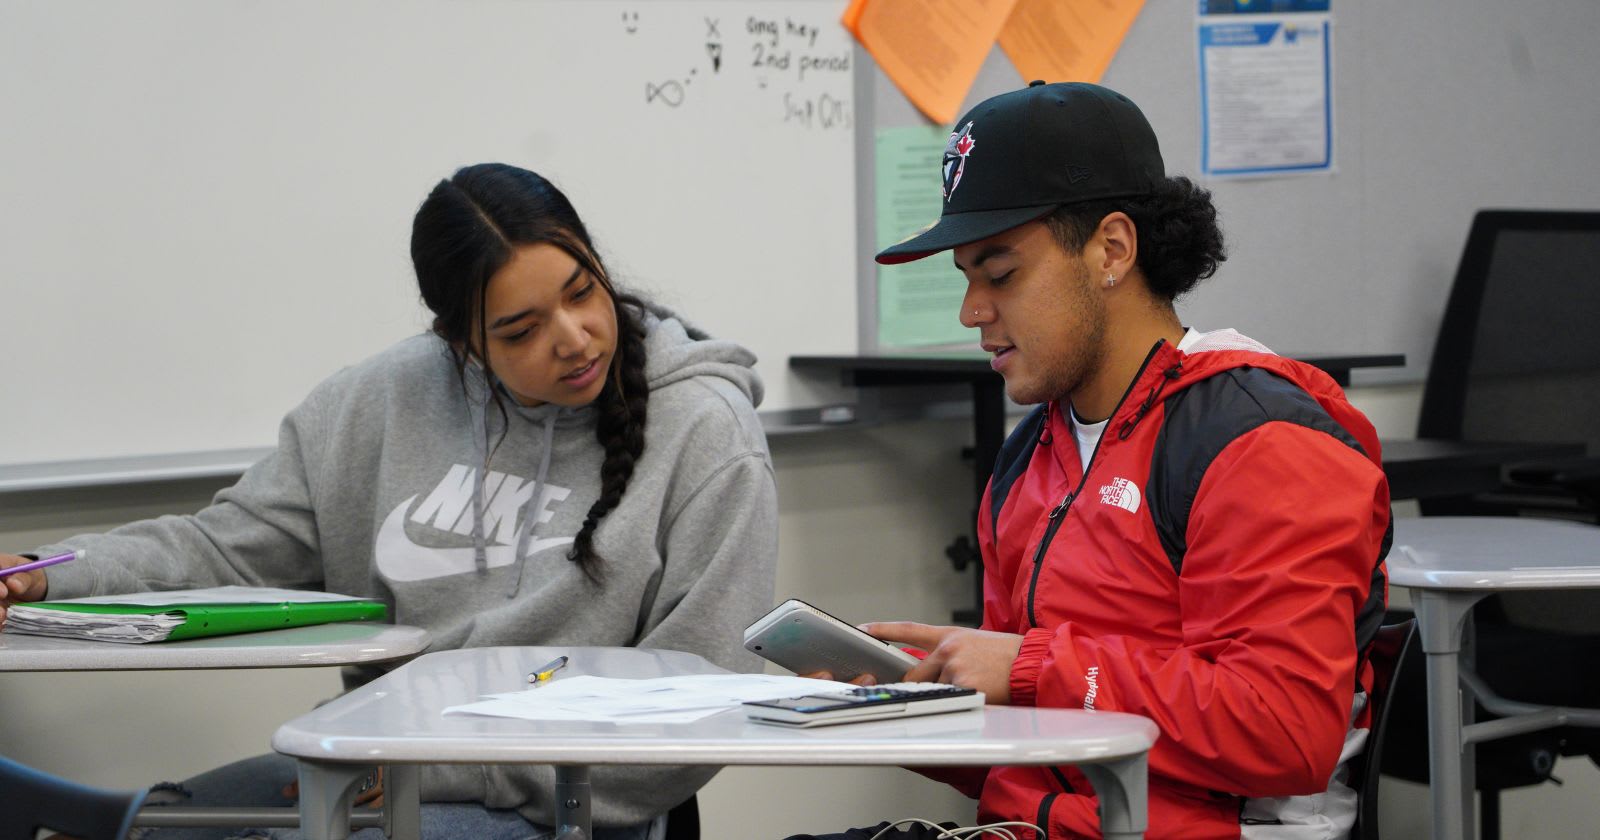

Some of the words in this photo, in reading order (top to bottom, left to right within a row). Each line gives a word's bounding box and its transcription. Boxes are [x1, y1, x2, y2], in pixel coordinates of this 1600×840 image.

[785, 17, 819, 48] hey
[752, 42, 791, 70] 2nd
[798, 51, 851, 81] period
[1099, 485, 1123, 498] NORTH
[1112, 477, 1128, 487] THE
[410, 464, 572, 546] NIKE
[1100, 495, 1120, 506] FACE
